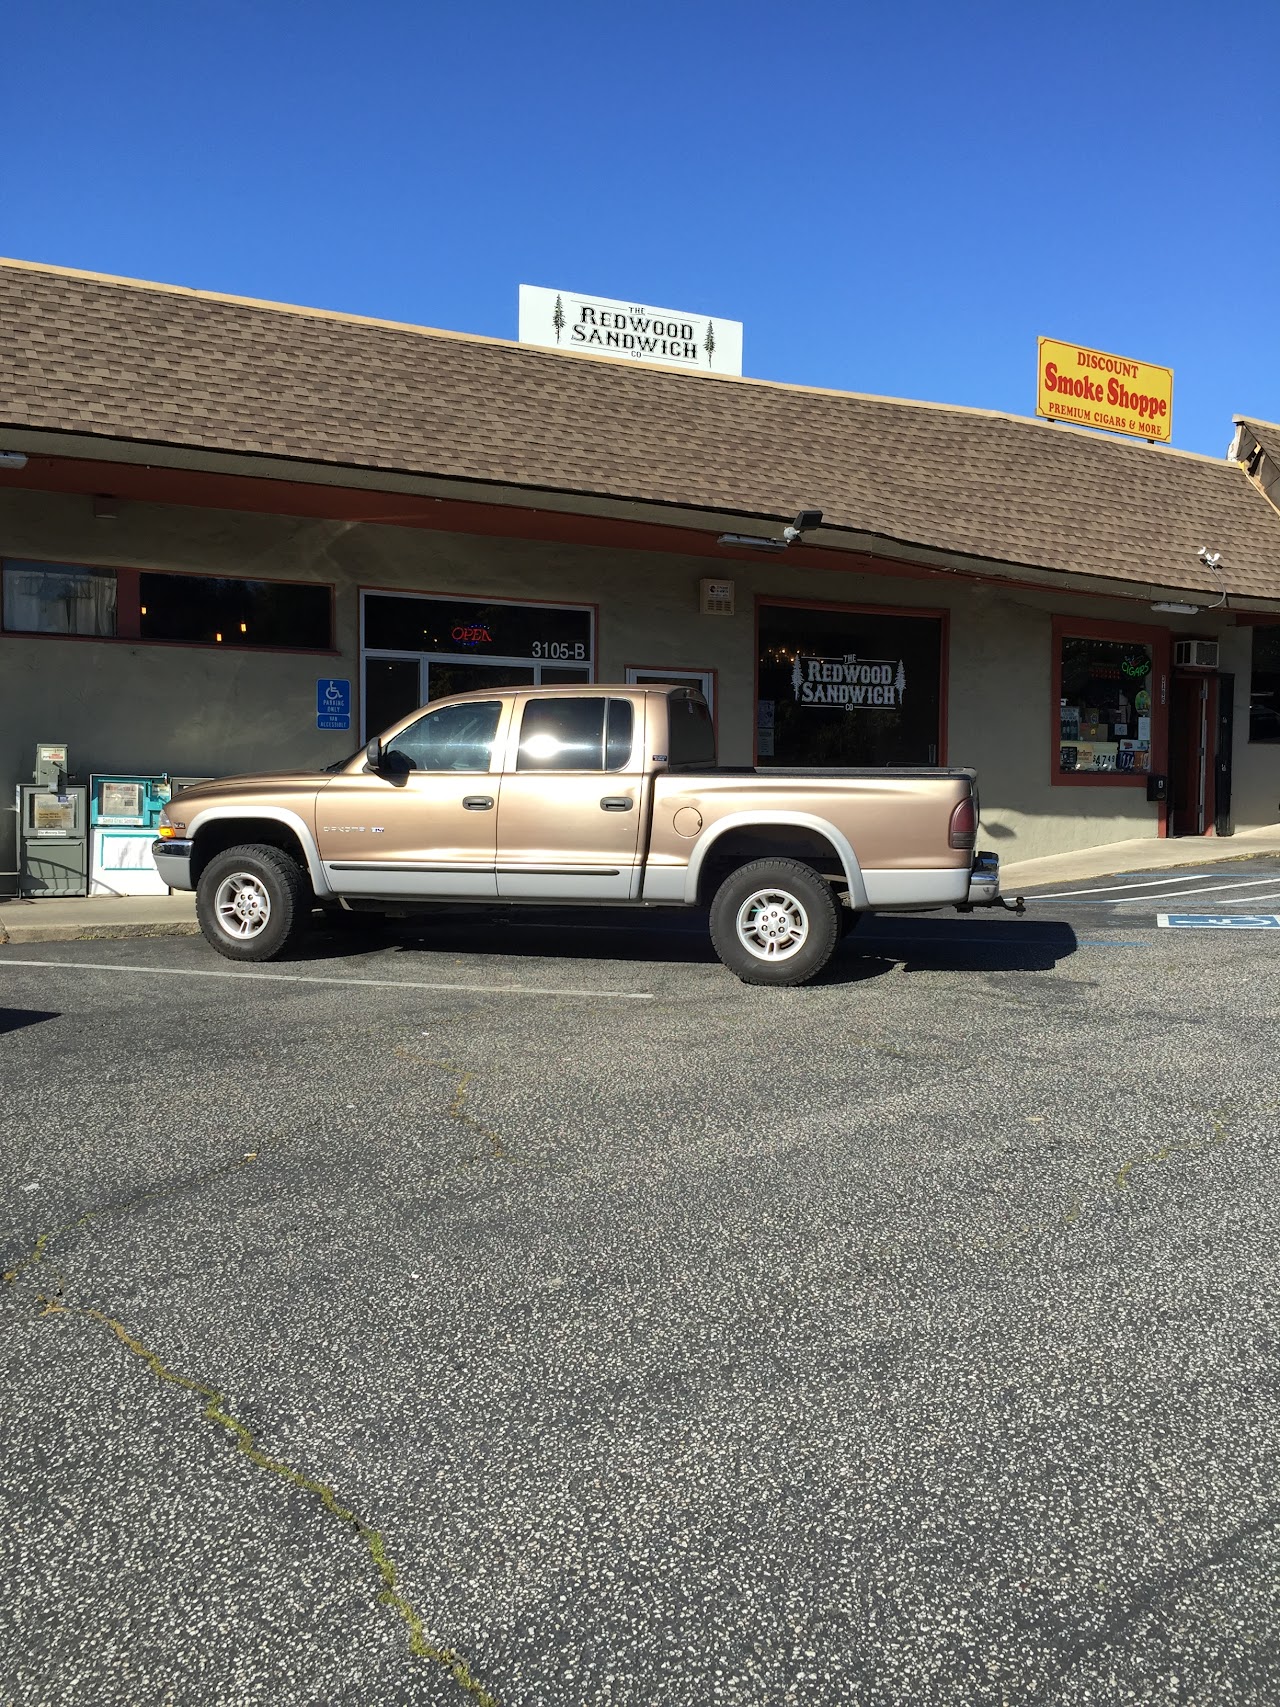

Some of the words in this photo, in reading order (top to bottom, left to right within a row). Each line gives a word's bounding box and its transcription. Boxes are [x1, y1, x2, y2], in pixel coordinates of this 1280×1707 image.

[628, 306, 646, 315] THE
[580, 306, 693, 341] REDWOOD
[571, 325, 697, 359] SANDWICH
[630, 350, 642, 359] CO
[1077, 351, 1139, 379] DISCOUNT
[1045, 362, 1104, 402] Smoke
[1107, 377, 1167, 419] Shoppe
[1048, 402, 1091, 420] PREMIUM
[1094, 412, 1126, 428] CIGARS
[1129, 419, 1136, 429] &
[1138, 422, 1162, 436] MORE
[452, 627, 492, 642] OPEN
[532, 641, 586, 660] 3105-B
[843, 654, 857, 663] THE
[807, 660, 892, 684] REDWOOD
[1121, 660, 1150, 677] CIGARS
[802, 682, 895, 705] SANDWICH
[845, 703, 854, 711] CO
